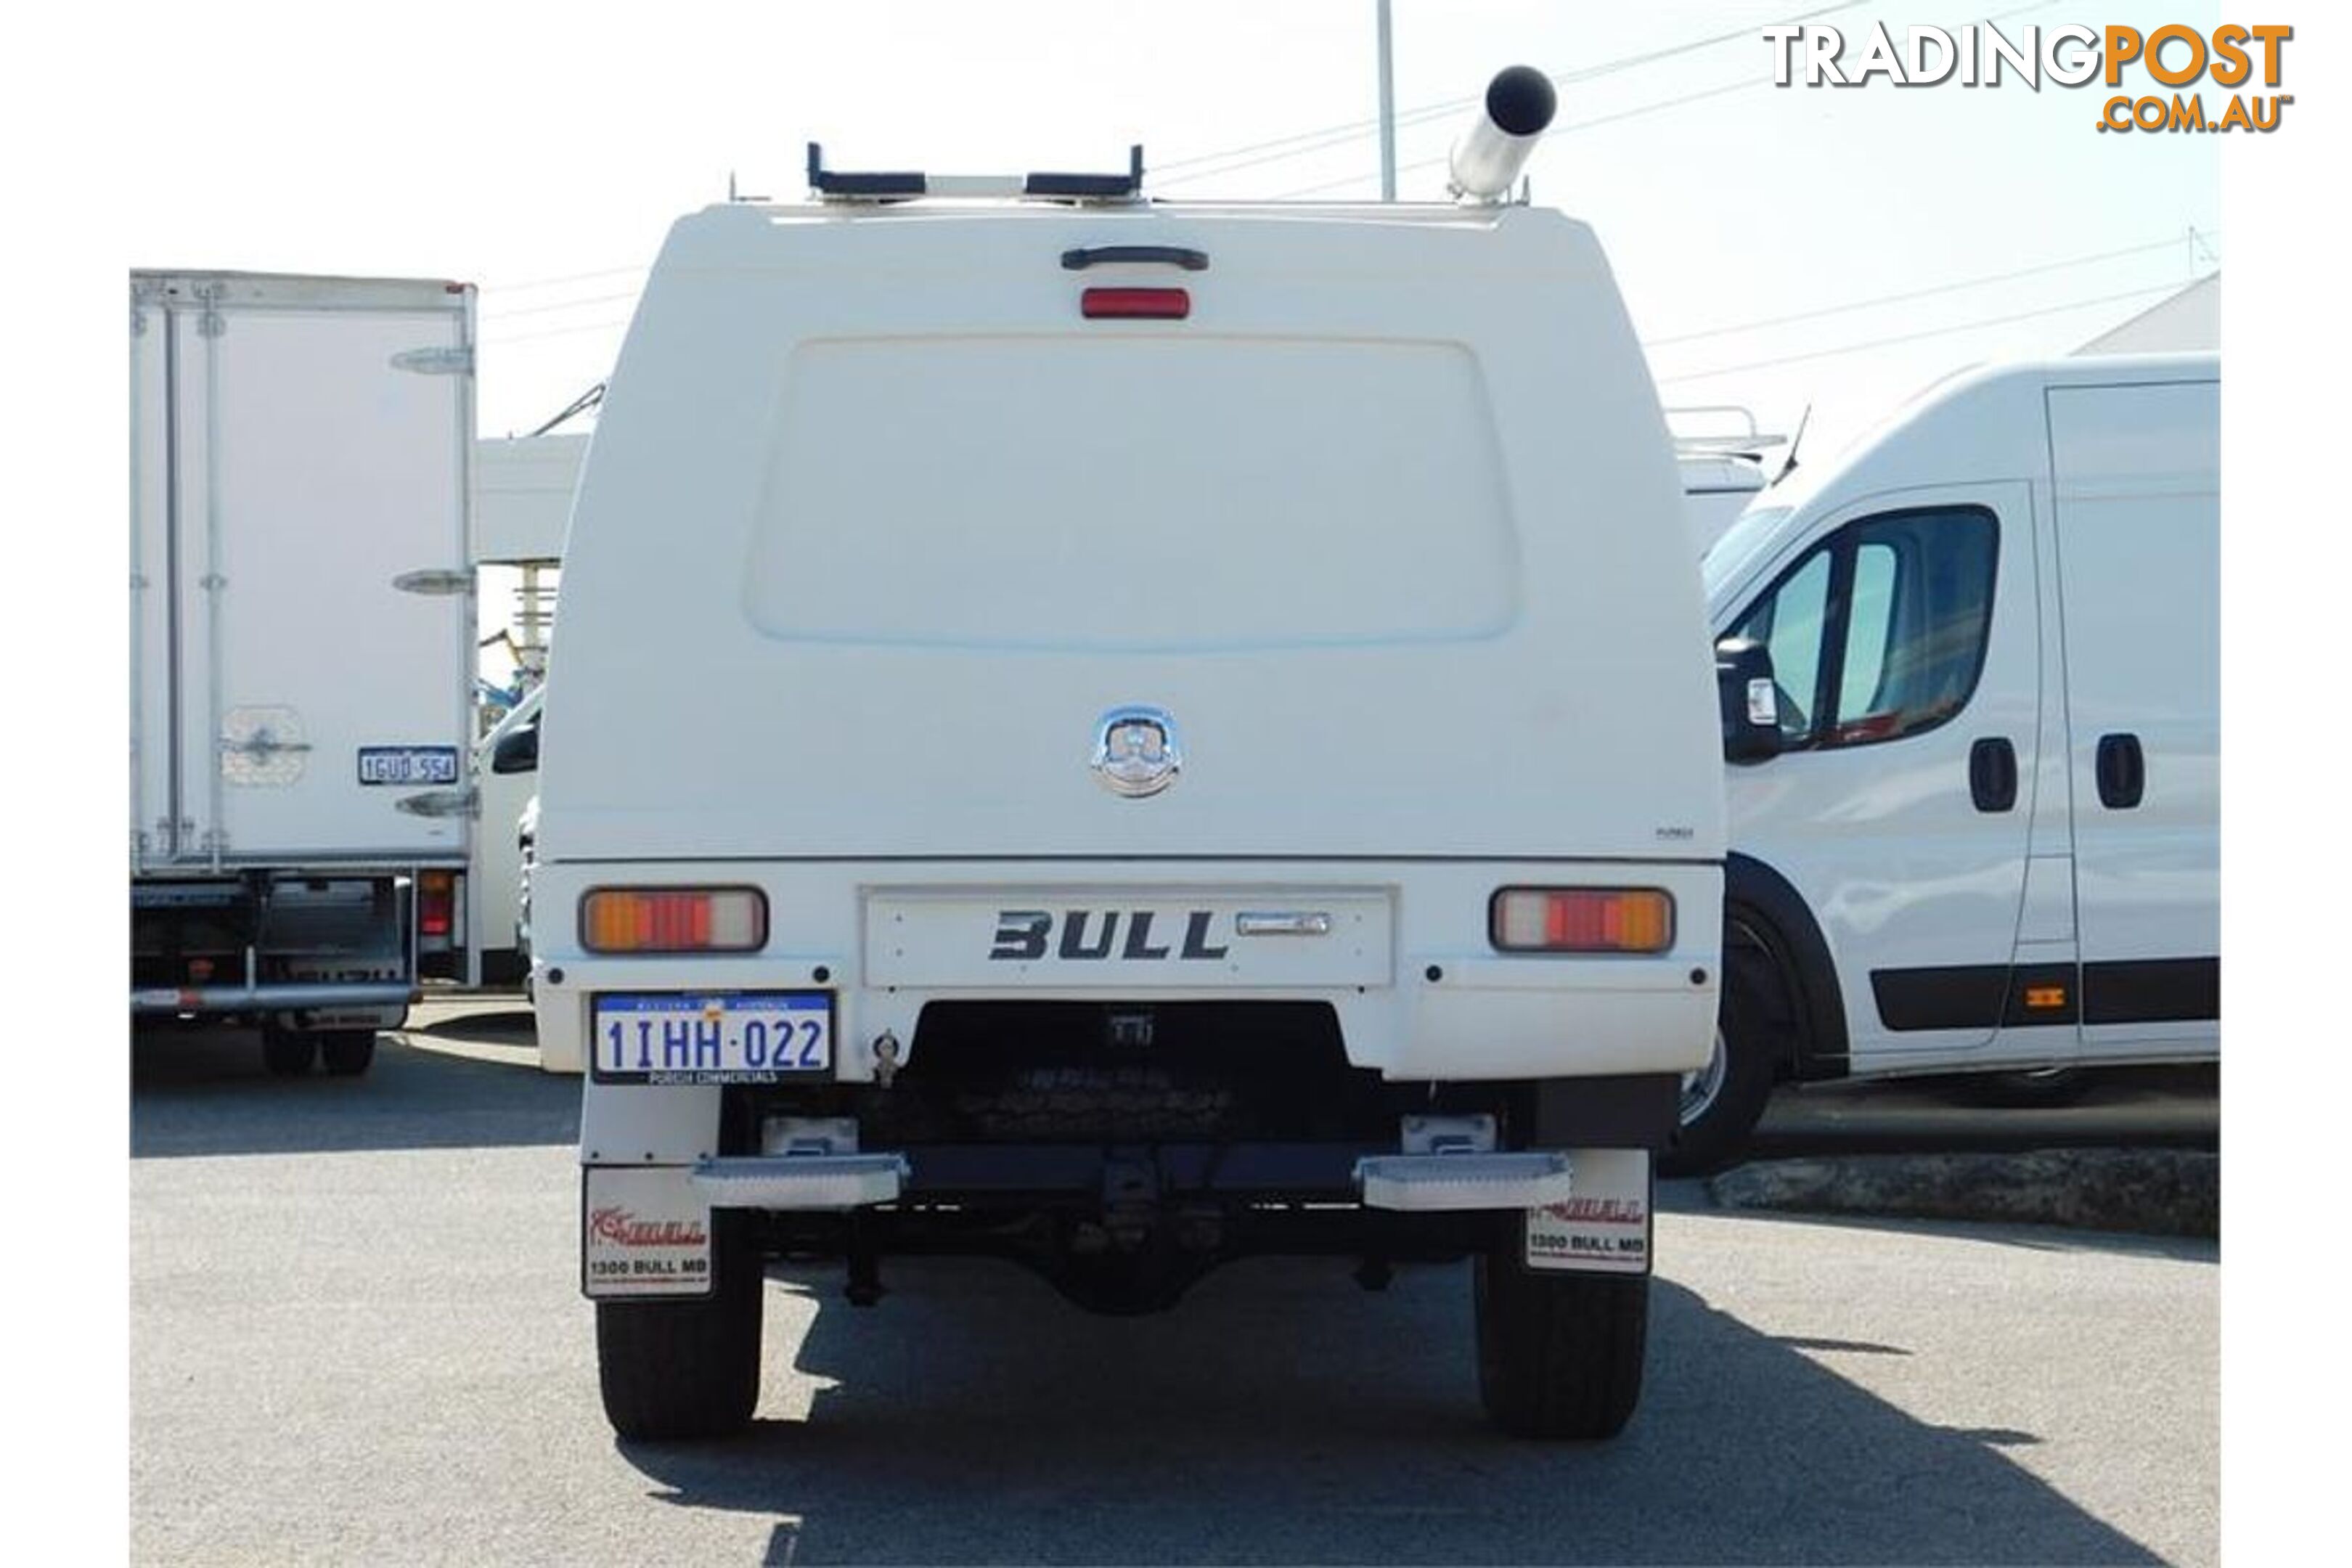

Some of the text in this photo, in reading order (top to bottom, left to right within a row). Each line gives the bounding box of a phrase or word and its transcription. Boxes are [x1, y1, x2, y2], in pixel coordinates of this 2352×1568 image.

[988, 911, 1229, 960] BULL
[1572, 1236, 1613, 1251] BULL
[634, 1259, 677, 1273] BULL
